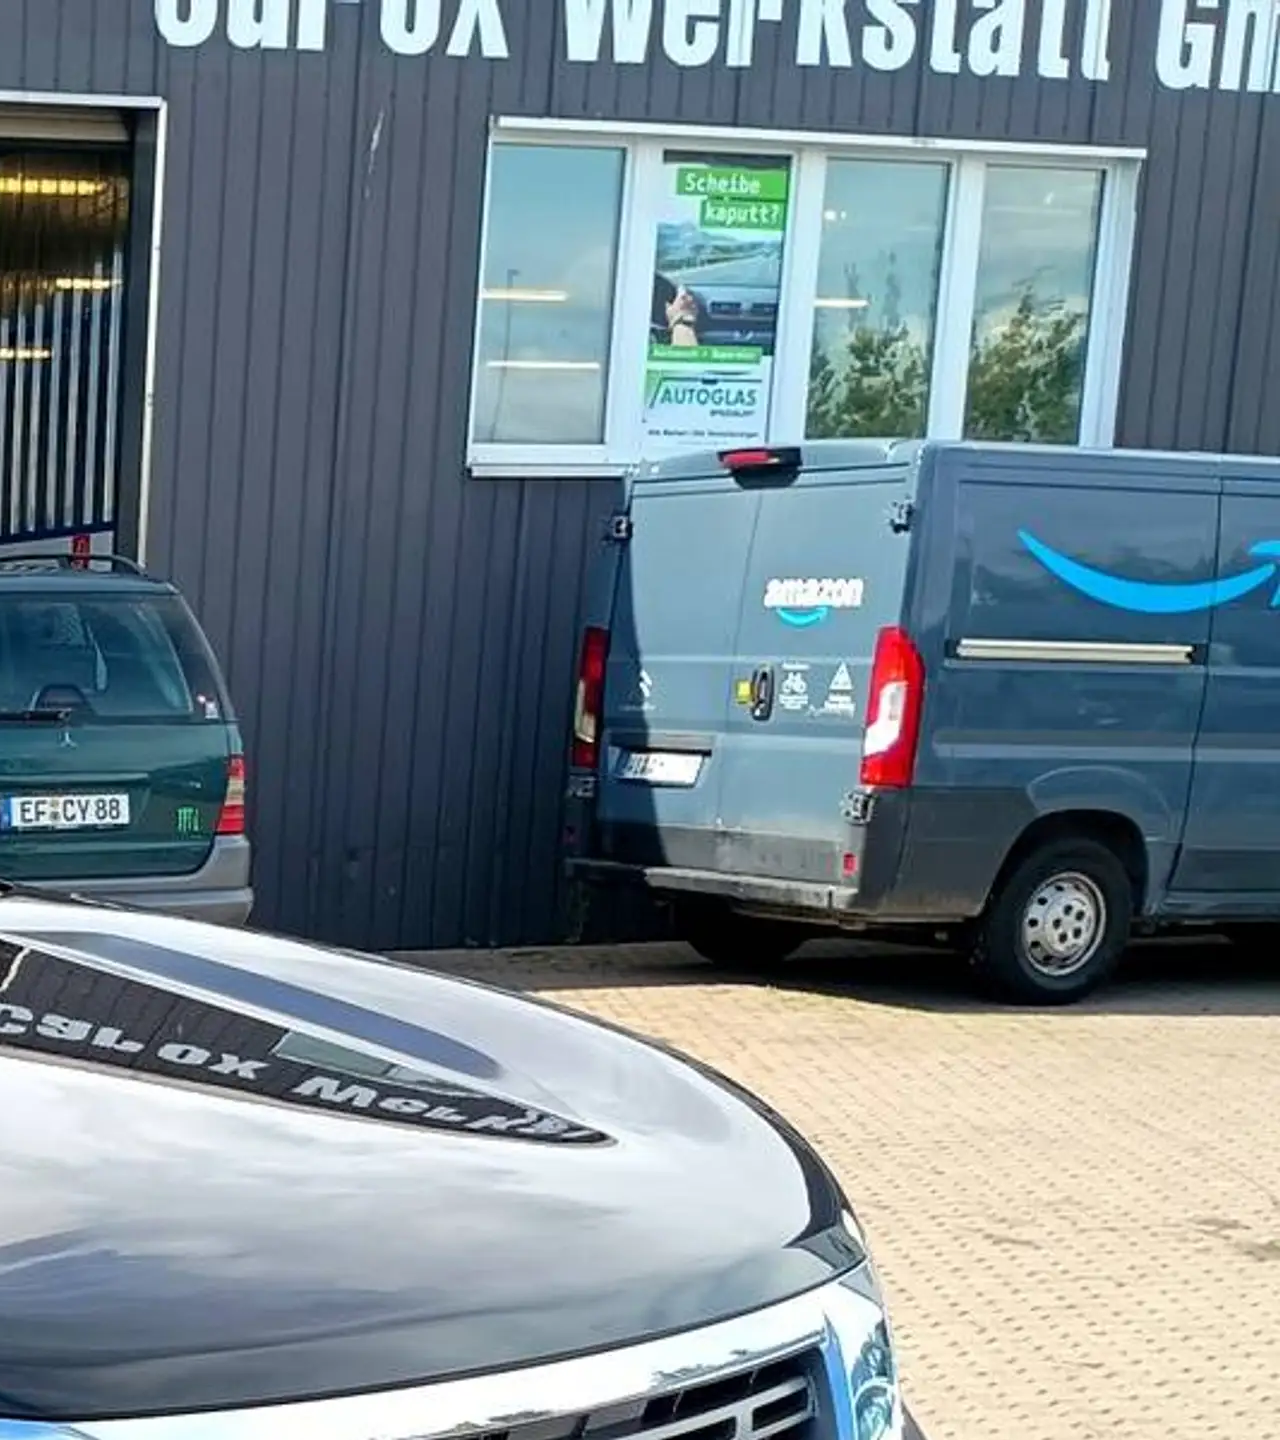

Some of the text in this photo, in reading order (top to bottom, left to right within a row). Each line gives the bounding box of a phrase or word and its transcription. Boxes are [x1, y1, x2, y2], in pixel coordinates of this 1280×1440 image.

[684, 172, 762, 194] Scheibe
[705, 202, 780, 225] kaputt?
[660, 388, 757, 406] AUTOGLAS
[763, 578, 863, 608] amazon
[19, 797, 121, 824] EF CY 88
